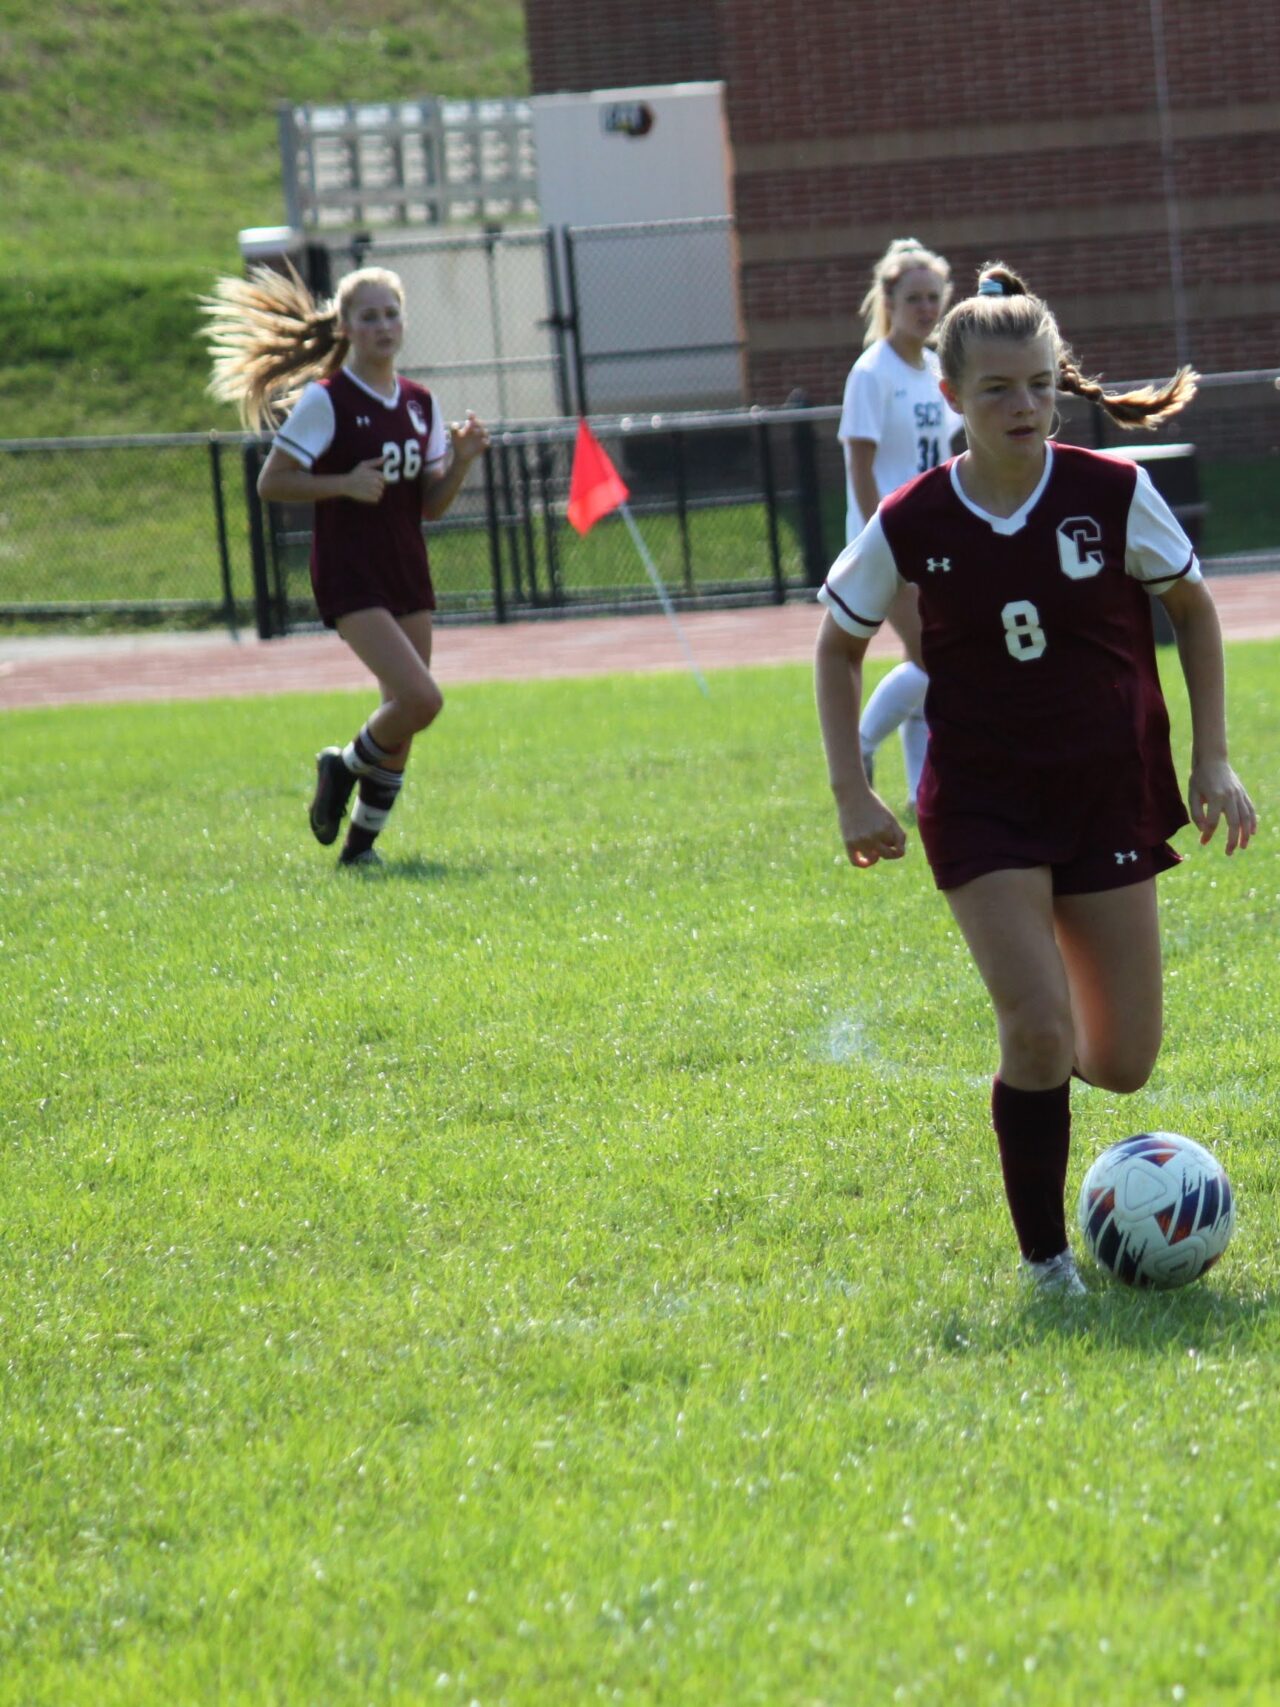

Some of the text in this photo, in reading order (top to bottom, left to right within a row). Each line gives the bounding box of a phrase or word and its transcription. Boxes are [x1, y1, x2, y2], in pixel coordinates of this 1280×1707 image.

[382, 438, 421, 481] 26
[1056, 516, 1105, 580] C
[1001, 599, 1047, 662] 8
